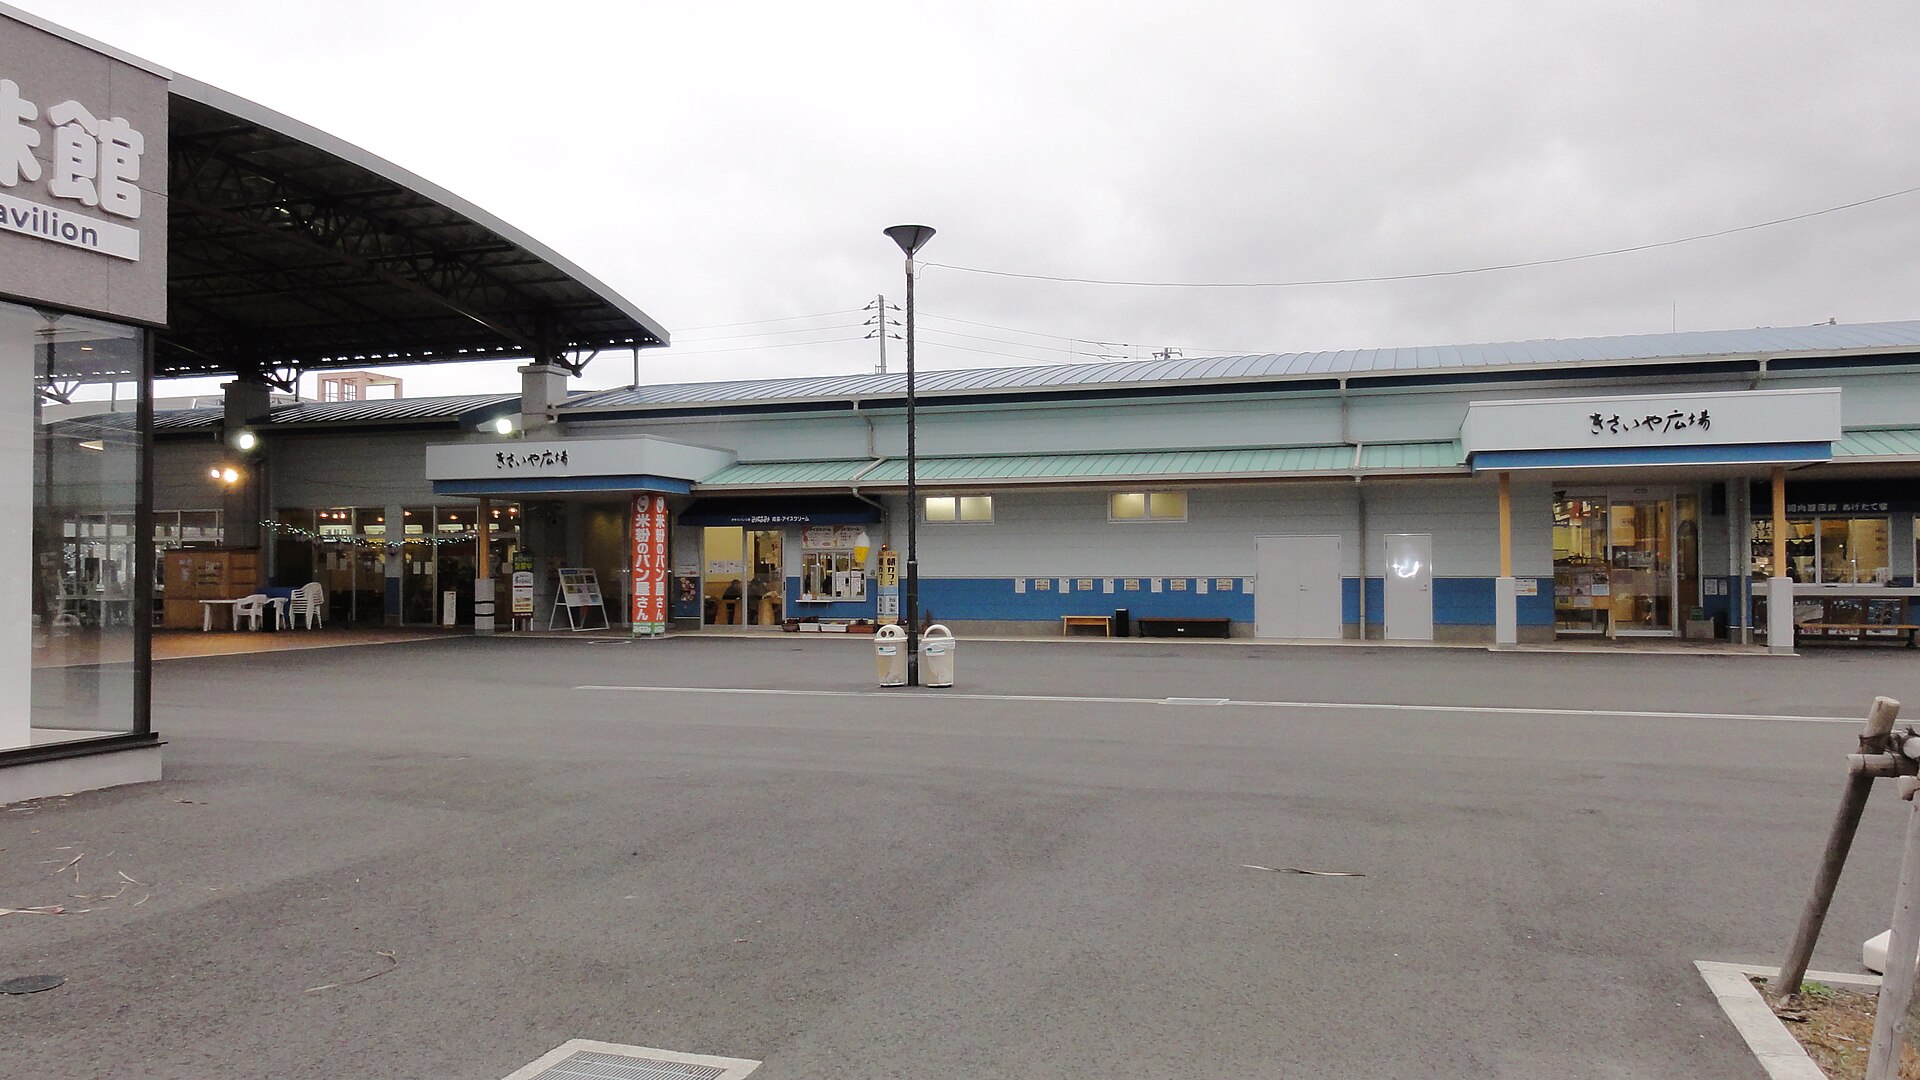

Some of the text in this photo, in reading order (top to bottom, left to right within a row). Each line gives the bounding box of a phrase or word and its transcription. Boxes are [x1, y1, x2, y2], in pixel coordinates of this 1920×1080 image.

[1589, 409, 1711, 435] きさいや広場
[496, 449, 569, 469] きさいや広場
[635, 513, 651, 621] 米粉のパン屋さん
[655, 513, 665, 621] 米粉のパン屋さん
[886, 557, 896, 586] 朝カフェ
